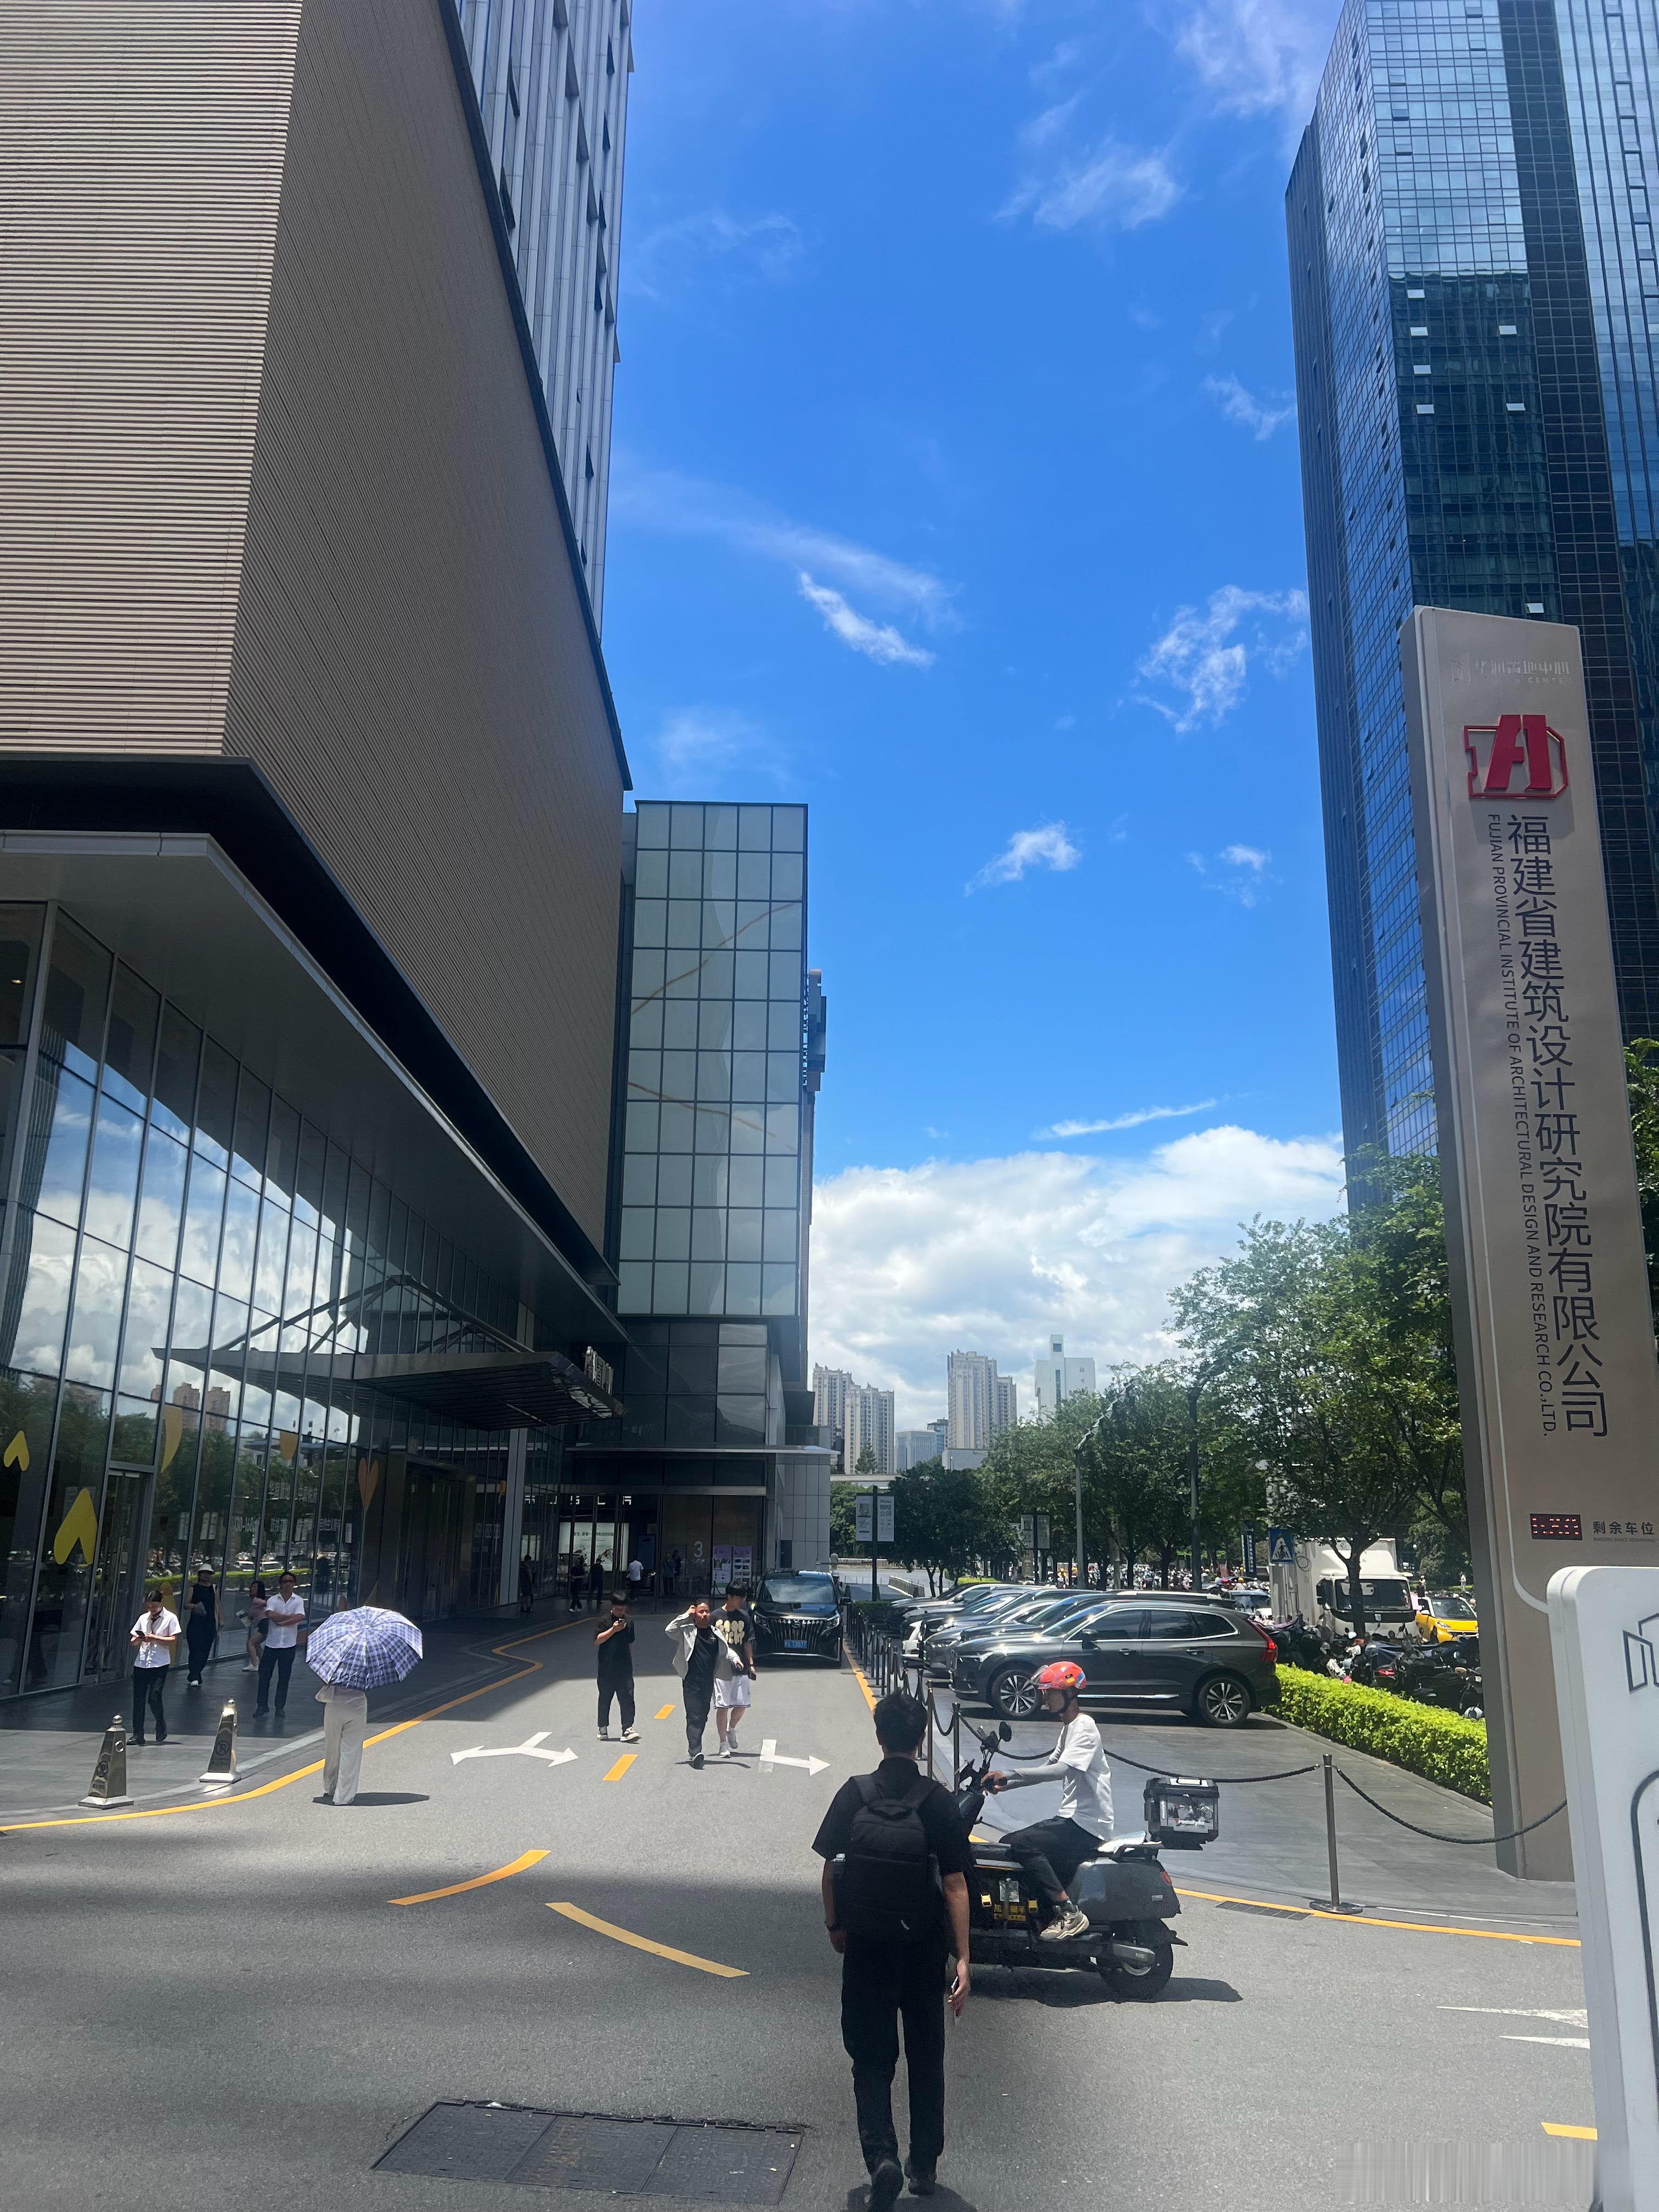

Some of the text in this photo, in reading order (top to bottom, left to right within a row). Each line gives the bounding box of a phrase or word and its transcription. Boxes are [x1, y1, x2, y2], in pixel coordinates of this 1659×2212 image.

[1487, 814, 1504, 862] FUJIAN
[1492, 867, 1512, 950] PROVINCIAL
[1500, 955, 1519, 1029] INSTITUTE
[1508, 1033, 1521, 1052] OF
[1507, 814, 1608, 1437] 福建省建筑设计研究院有限公司
[1509, 1056, 1533, 1179] ARCHITECTURAL
[1521, 1184, 1539, 1240] DESIGN
[1527, 1244, 1542, 1277] AND
[1531, 1282, 1550, 1365] RESEARCH
[693, 1541, 703, 1558] 3
[1593, 1521, 1655, 1535] 剩余车位
